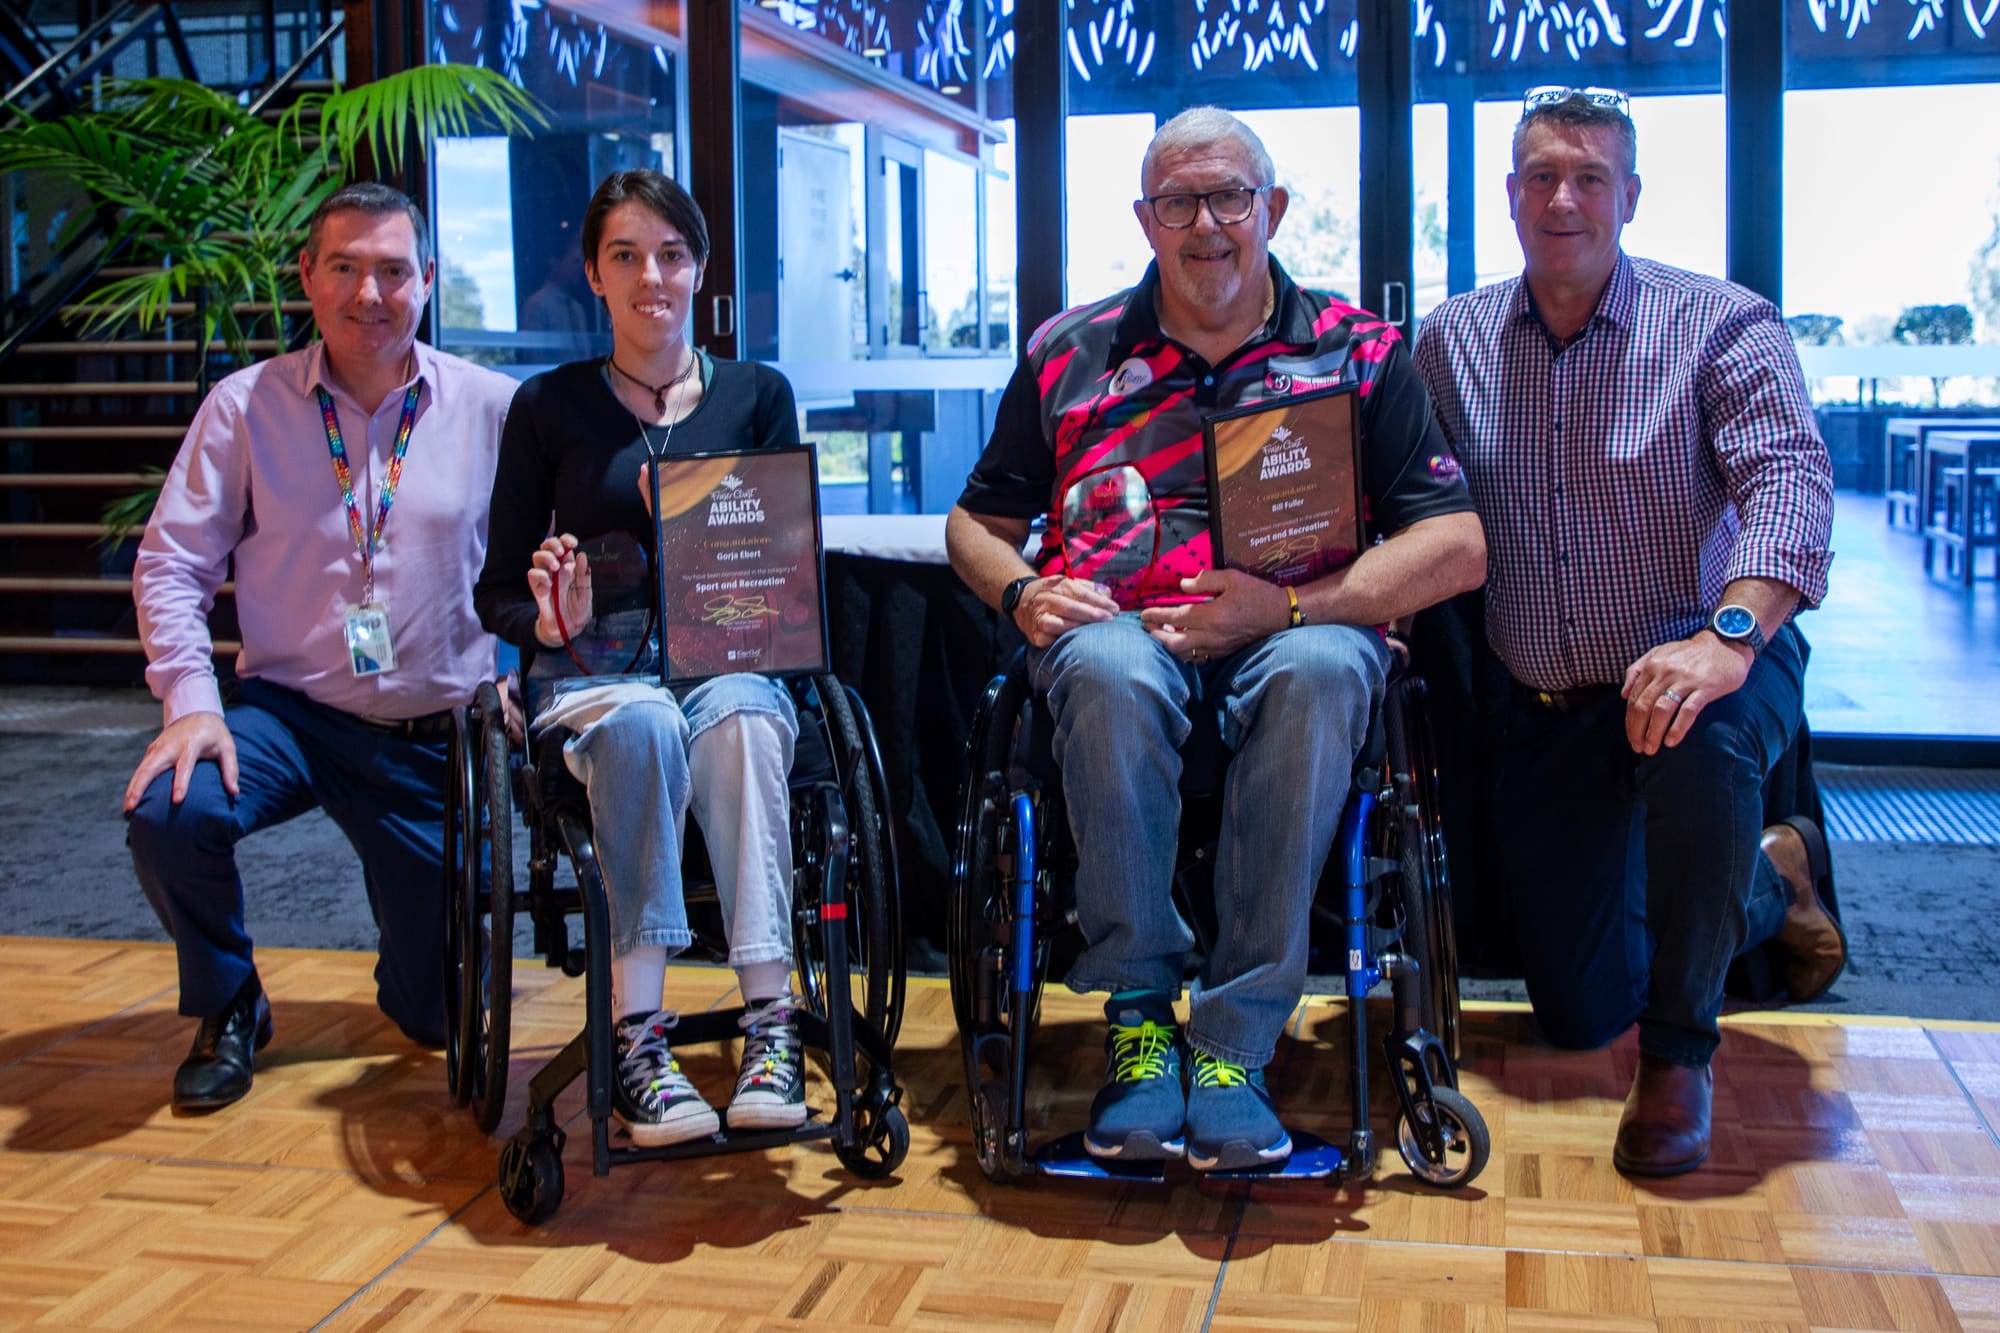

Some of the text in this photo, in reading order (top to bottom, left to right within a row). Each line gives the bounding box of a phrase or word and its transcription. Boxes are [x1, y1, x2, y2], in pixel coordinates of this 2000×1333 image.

[1262, 447, 1308, 468] ABILITY
[1260, 458, 1312, 481] AWARDS
[710, 499, 761, 514] ABILITY
[1272, 498, 1305, 513] Bill Fuller
[708, 511, 766, 527] AWARDS
[1250, 520, 1330, 547] Sport and Recreation
[703, 536, 772, 549] Congratulations
[716, 550, 761, 562] Gorja Ebert
[695, 576, 786, 595] Sport and Recreation
